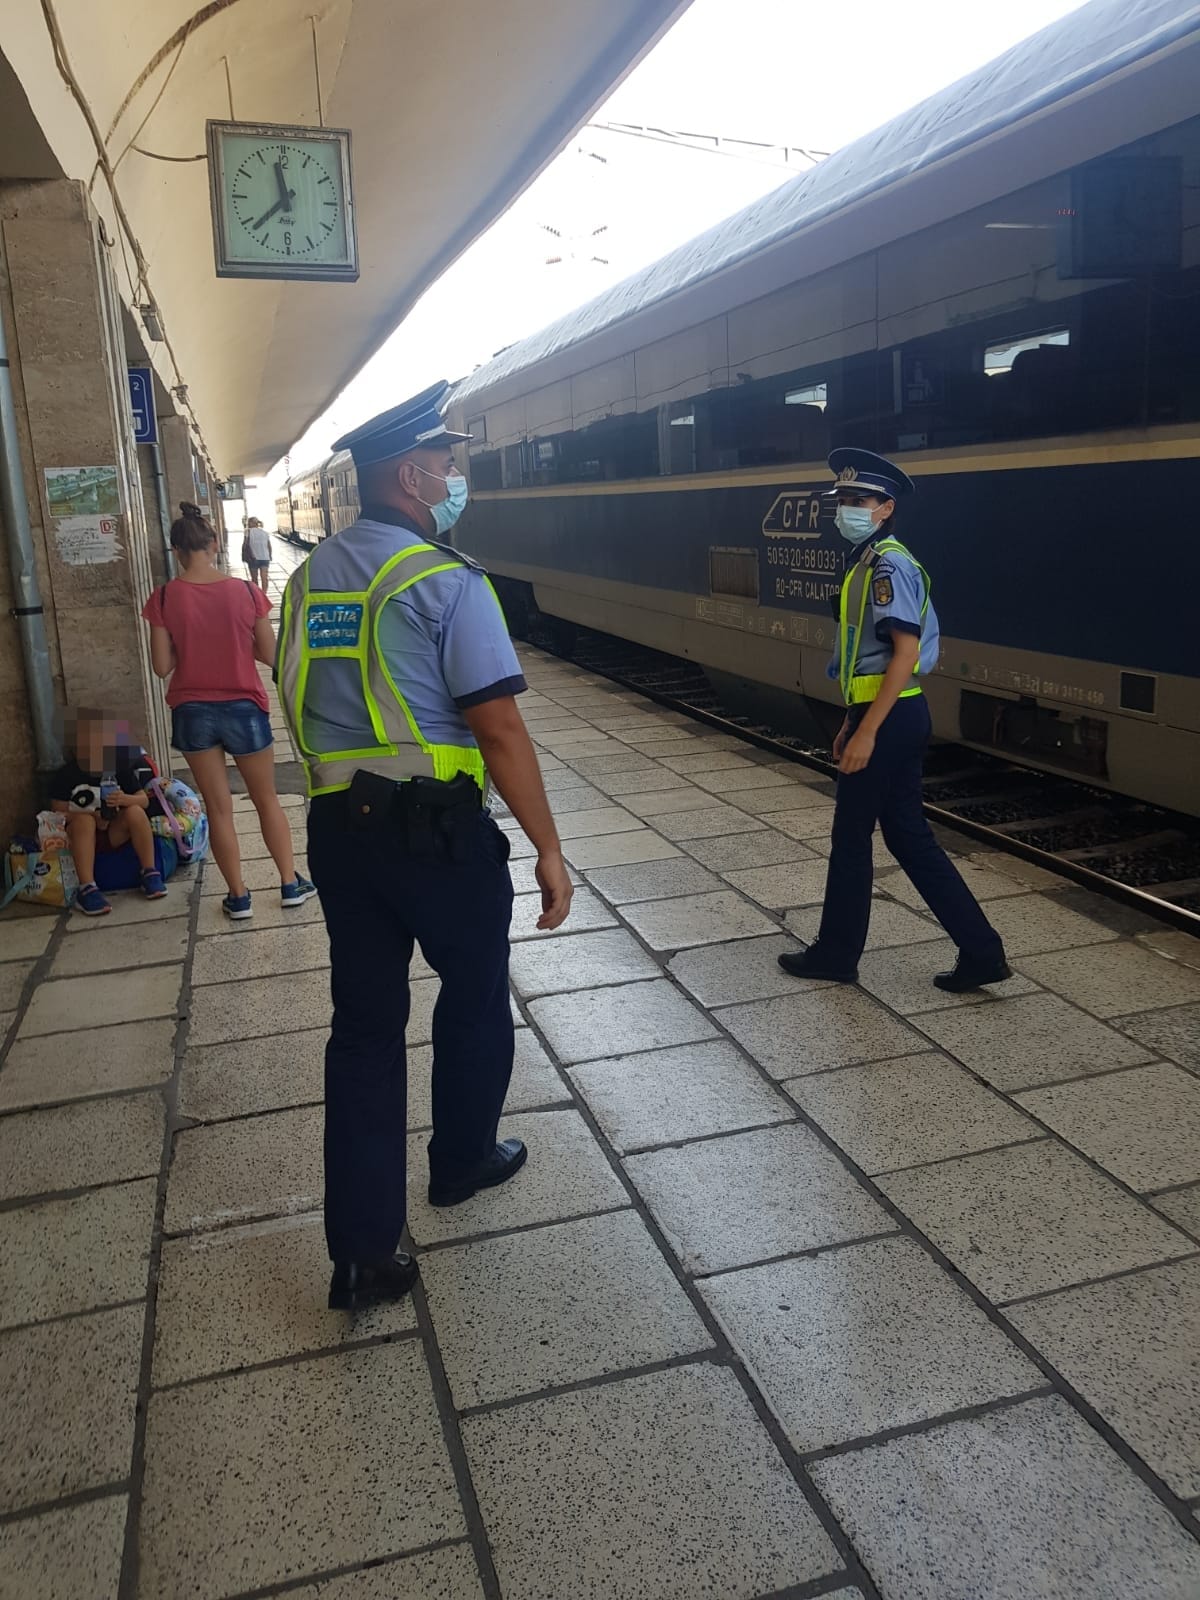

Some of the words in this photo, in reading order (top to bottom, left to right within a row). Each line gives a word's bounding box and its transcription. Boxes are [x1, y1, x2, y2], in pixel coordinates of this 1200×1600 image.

[278, 154, 289, 170] 12
[284, 231, 292, 246] 6
[133, 381, 140, 390] 2
[783, 500, 820, 528] CFR
